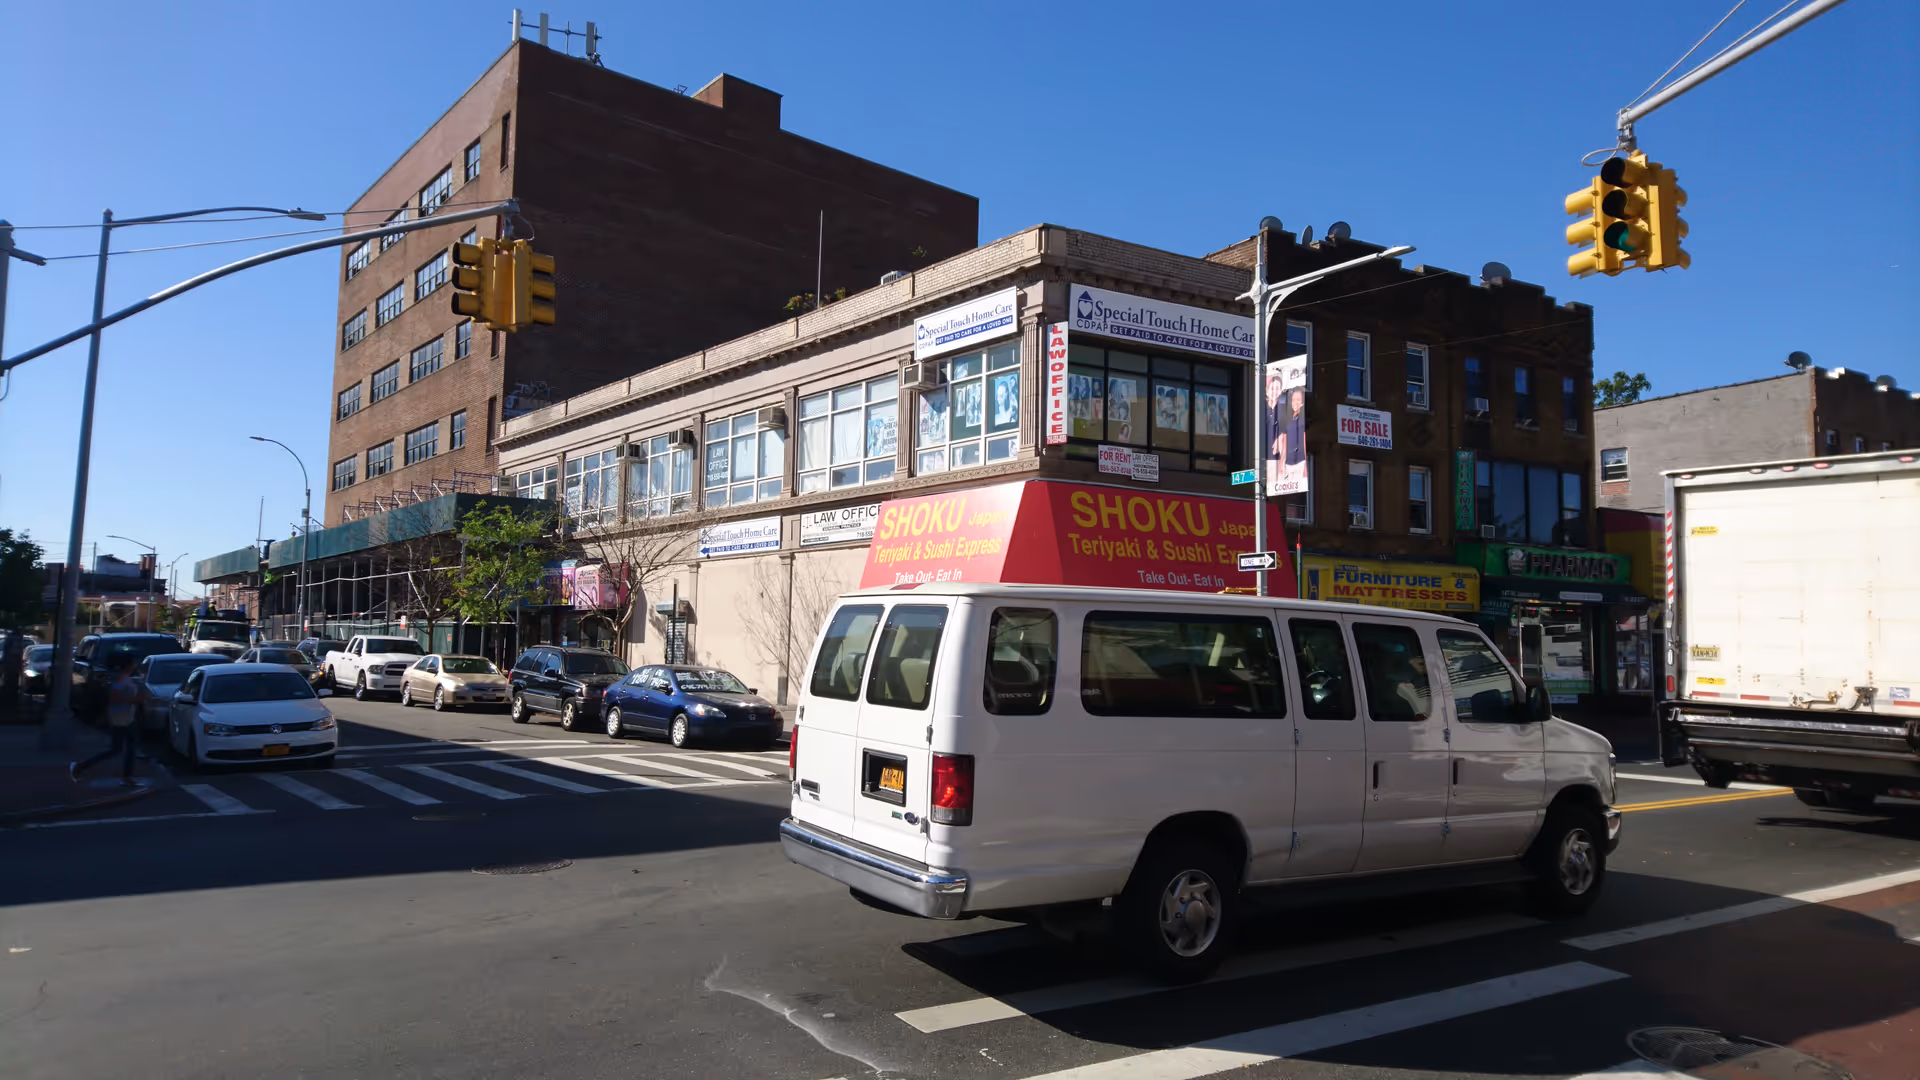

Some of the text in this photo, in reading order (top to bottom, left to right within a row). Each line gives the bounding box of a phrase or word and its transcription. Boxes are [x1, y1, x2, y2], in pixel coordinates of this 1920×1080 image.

[925, 303, 1013, 338] Special Touch Home Care
[961, 329, 972, 337] CARE
[973, 326, 981, 334] FOR
[987, 319, 1001, 329] LOVED
[1076, 318, 1108, 332] CDPAP
[1094, 300, 1255, 343] Special Touch Home Car
[1112, 326, 1128, 335] GET
[1130, 329, 1151, 339] PAID
[1153, 333, 1163, 342] TO
[1165, 336, 1187, 346] CARE
[1215, 344, 1241, 355] LOVED
[1242, 349, 1255, 357] ON
[1048, 325, 1067, 434] LAW OFFICE
[1341, 417, 1389, 438] FOR SALE
[712, 447, 725, 459] LAW
[1100, 450, 1132, 464] FOR RENT
[1143, 454, 1158, 463] OFFICE
[708, 458, 728, 471] OFFICE
[1232, 472, 1245, 483] 147
[814, 511, 836, 524] LAW
[880, 497, 1008, 541] SHOKU Japan
[1070, 490, 1256, 539] SHOKU Japa
[726, 528, 743, 540] Touch
[744, 527, 762, 538] Home
[763, 525, 777, 536] Care
[874, 537, 1003, 567] Teriyaki & Sushi Express
[1068, 533, 1140, 562] Teriyaki
[1146, 539, 1159, 560] &
[1162, 540, 1209, 563] Sushi
[1243, 557, 1271, 566] ONE WAY
[1530, 553, 1620, 580] PHARMACY
[895, 571, 914, 584] Take
[936, 568, 951, 582] Eat
[953, 568, 963, 580] In
[1137, 570, 1165, 585] Take
[1194, 573, 1213, 587] Eat
[1215, 575, 1225, 587] In
[1333, 570, 1442, 588] FURNITURE
[1454, 578, 1466, 589] &
[1333, 584, 1468, 602] MATTRESSES
